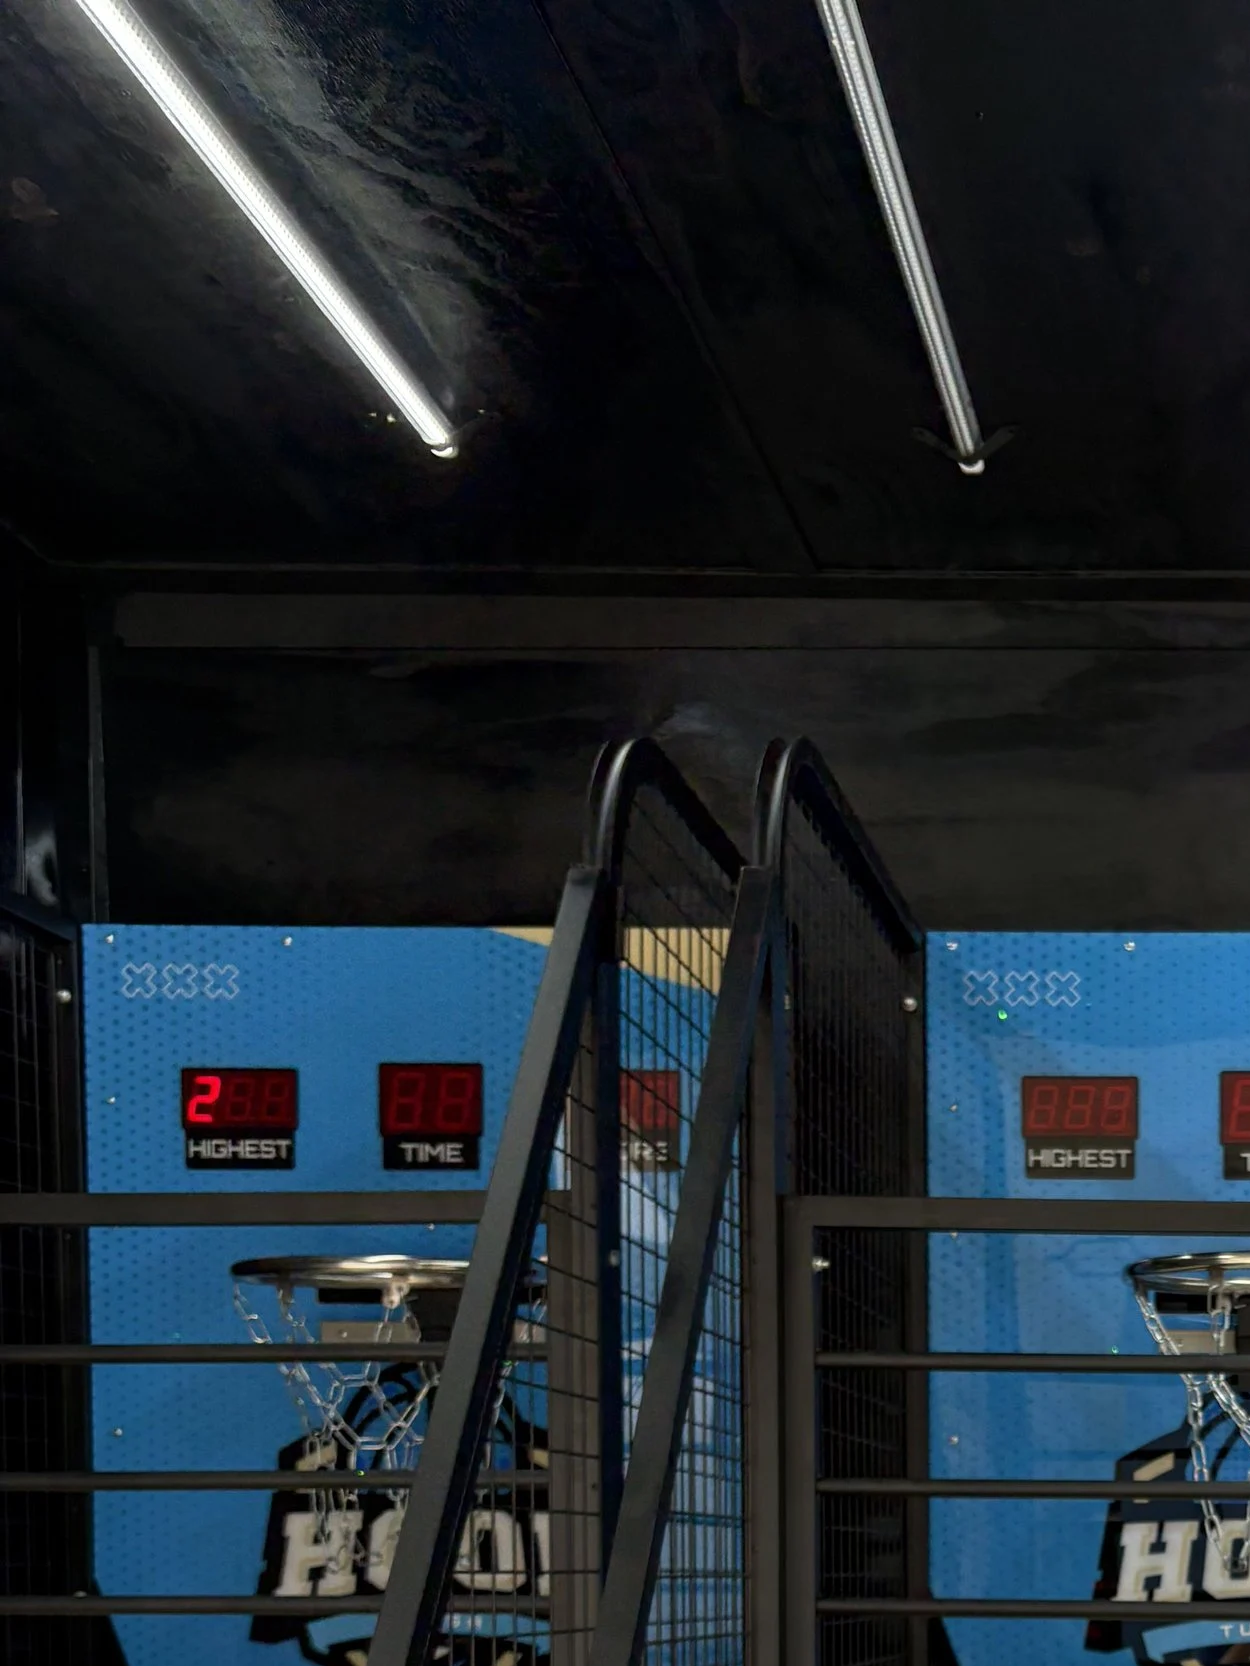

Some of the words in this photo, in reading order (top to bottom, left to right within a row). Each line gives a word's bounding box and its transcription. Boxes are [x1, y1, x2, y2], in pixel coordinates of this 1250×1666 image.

[187, 1075, 221, 1123] 2
[188, 1138, 292, 1160] HIGHEST
[400, 1142, 465, 1163] TIME
[1027, 1149, 1132, 1168] HIGHEST
